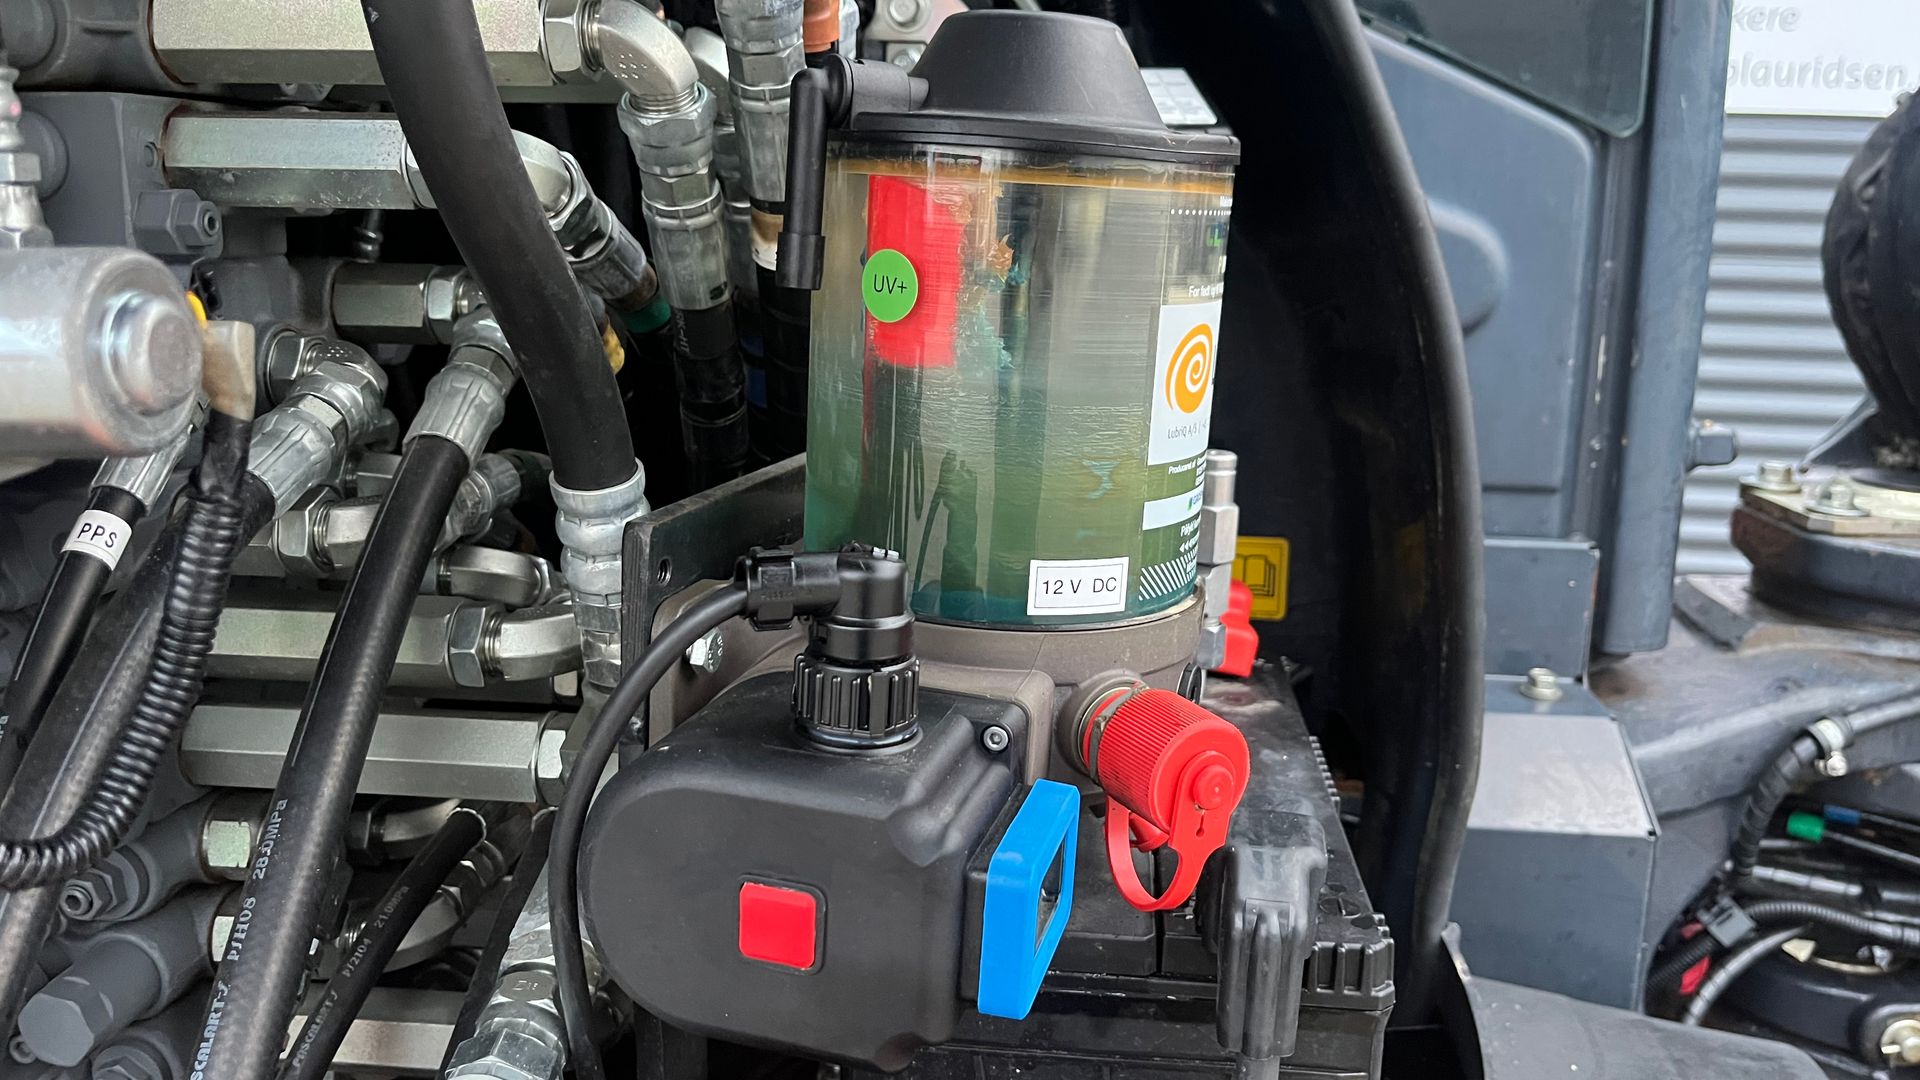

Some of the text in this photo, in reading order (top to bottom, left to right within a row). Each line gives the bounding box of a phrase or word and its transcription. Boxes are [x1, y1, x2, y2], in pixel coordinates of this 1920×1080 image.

[873, 274, 907, 294] UV+
[77, 522, 117, 548] PPS
[1092, 576, 1118, 593] DC
[252, 799, 288, 880] 28.0MPa
